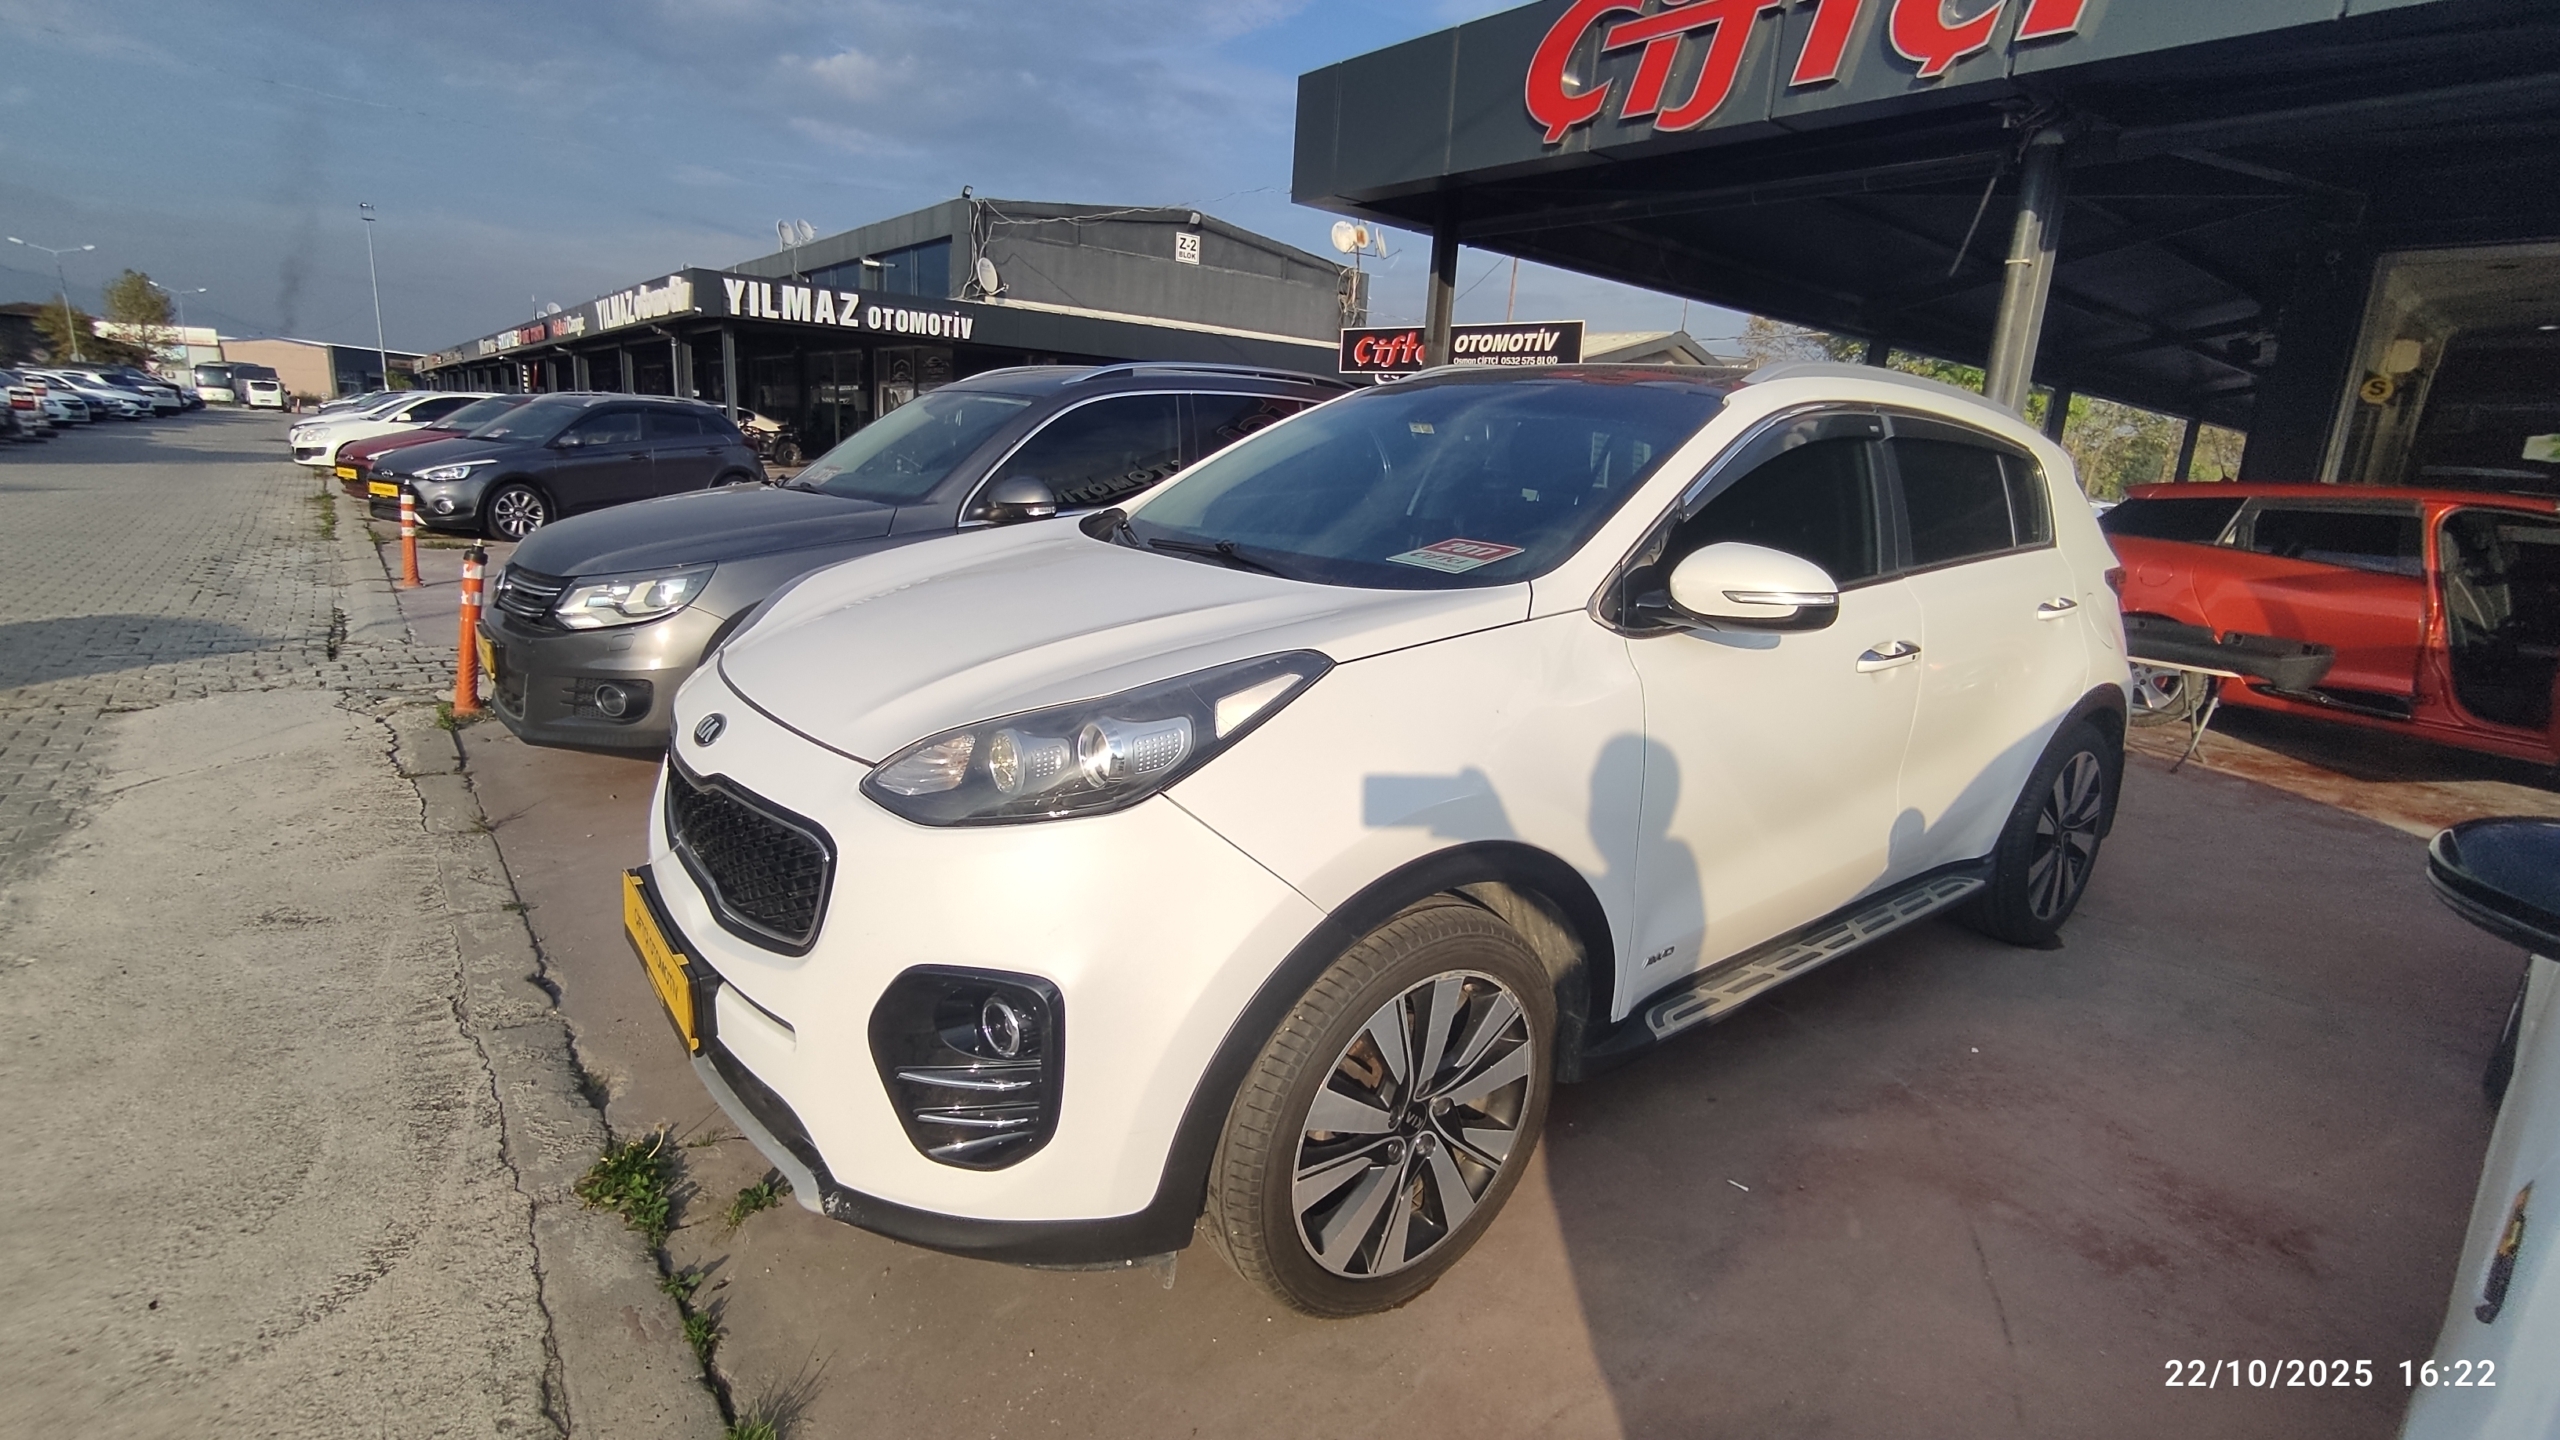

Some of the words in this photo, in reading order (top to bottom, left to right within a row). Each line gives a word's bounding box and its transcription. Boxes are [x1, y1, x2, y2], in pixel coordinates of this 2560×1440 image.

[1179, 237, 1197, 251] Z-2
[1179, 251, 1196, 260] BLOK
[596, 290, 635, 330] YILMAZ
[723, 277, 859, 328] YILMAZ
[867, 306, 974, 339] OTOMOTİV
[1454, 328, 1560, 353] OTOMOTİV
[1500, 356, 1521, 365] 0532
[1521, 356, 1536, 365] 575
[1405, 1111, 1424, 1130] KIA
